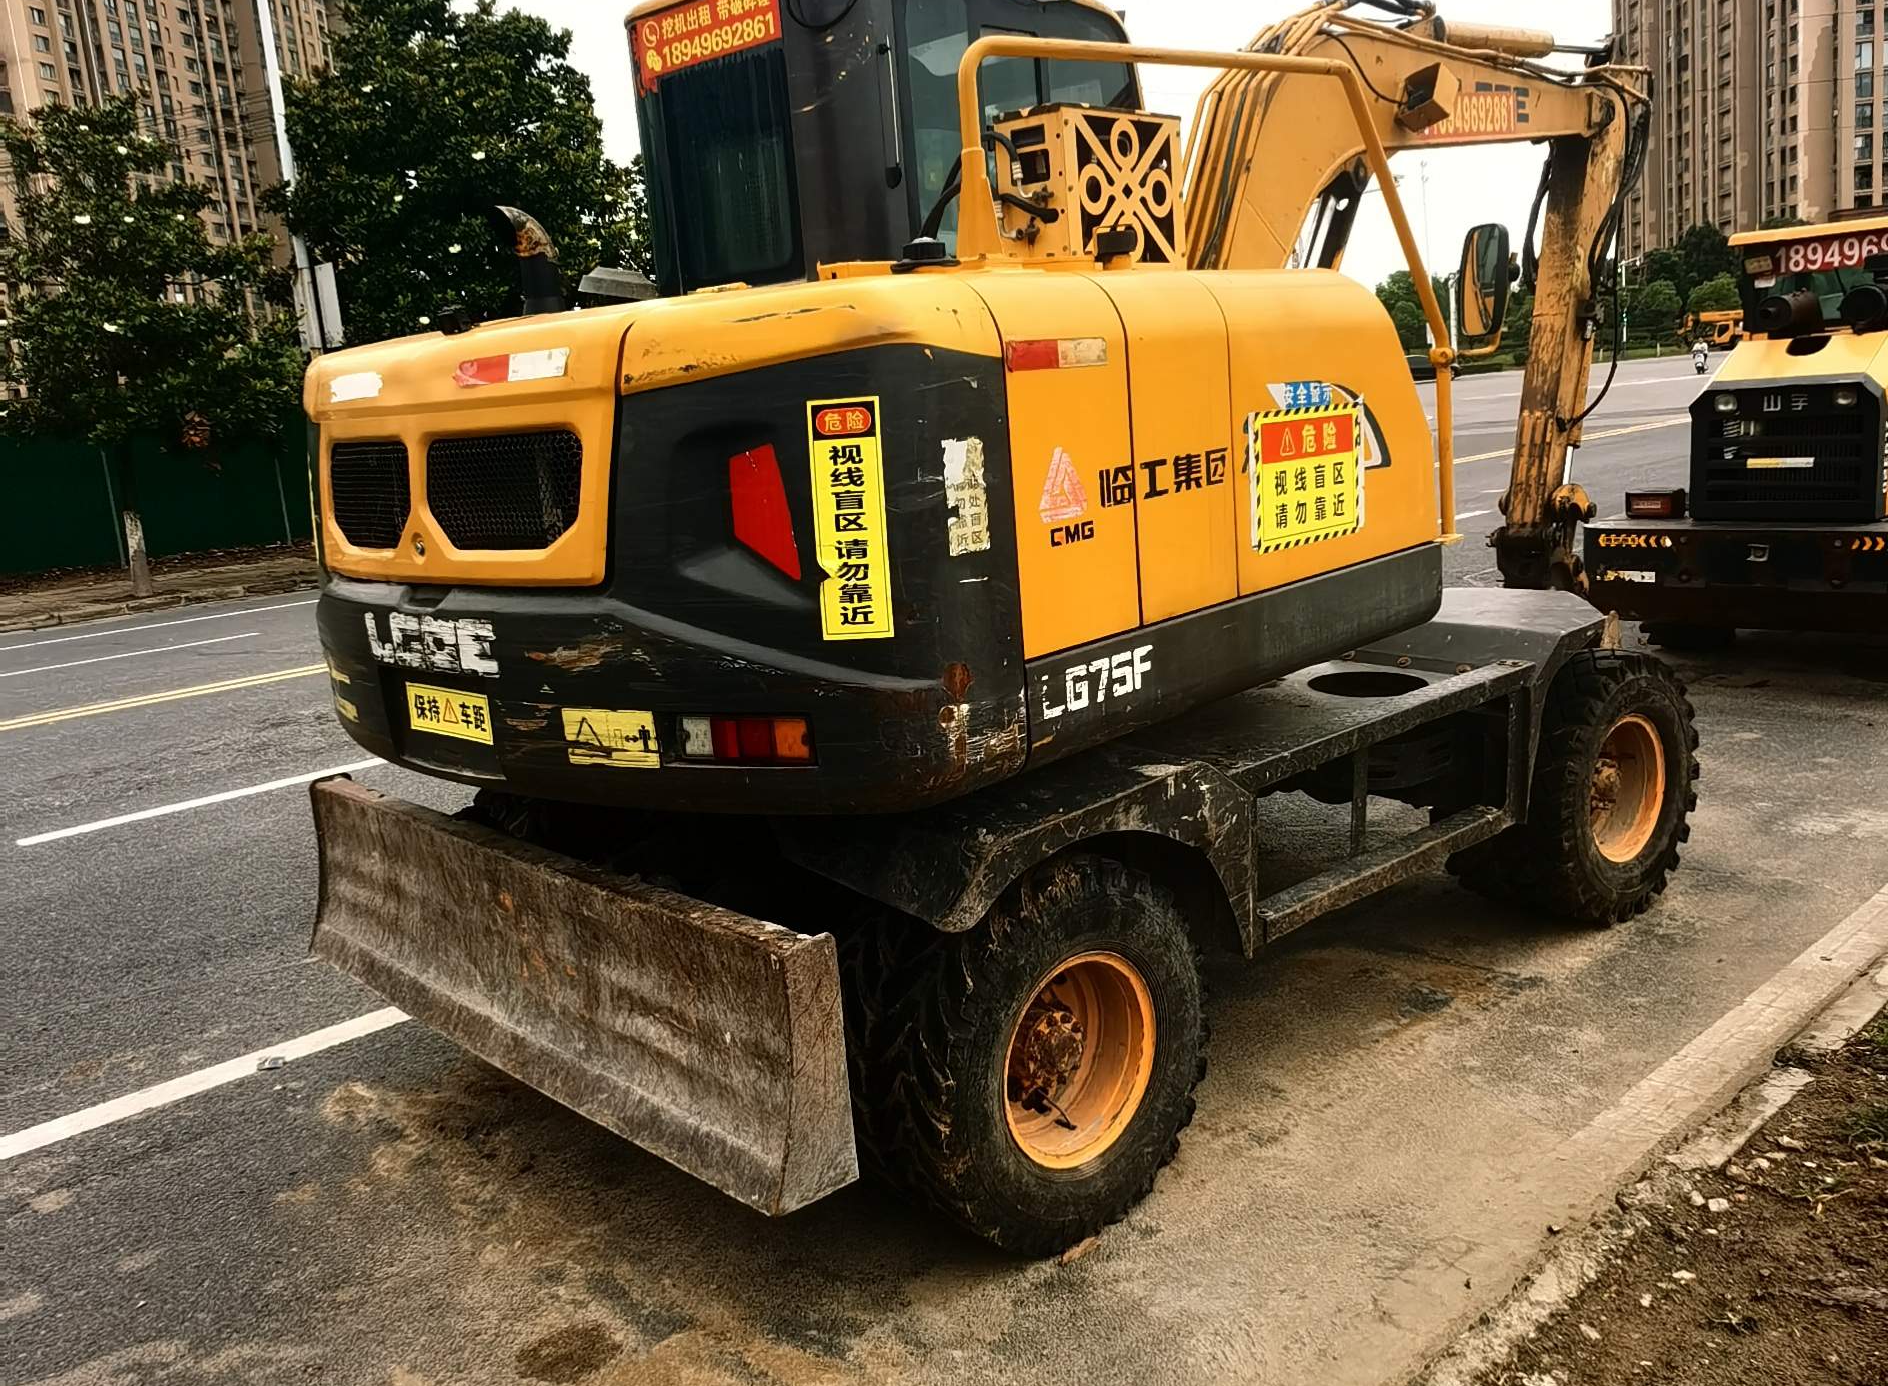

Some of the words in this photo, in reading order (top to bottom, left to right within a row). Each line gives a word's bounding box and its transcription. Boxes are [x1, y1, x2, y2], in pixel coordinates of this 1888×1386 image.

[661, 4, 711, 40] 挖机出租
[662, 11, 775, 68] 18949692861
[1775, 233, 1888, 273] 189496
[1283, 382, 1333, 405] 安全警示
[824, 413, 864, 431] 危险
[1302, 421, 1338, 453] 危险
[829, 444, 867, 532] 视线盲区
[1099, 447, 1229, 508] 临工集团
[1274, 461, 1345, 497] 视线盲区
[1275, 492, 1345, 530] 请勿靠近
[1050, 520, 1094, 547] CMG
[835, 539, 874, 625] 请勿靠近
[1041, 644, 1153, 720] LG75F
[414, 693, 440, 723] 保持
[459, 701, 487, 732] 车距
